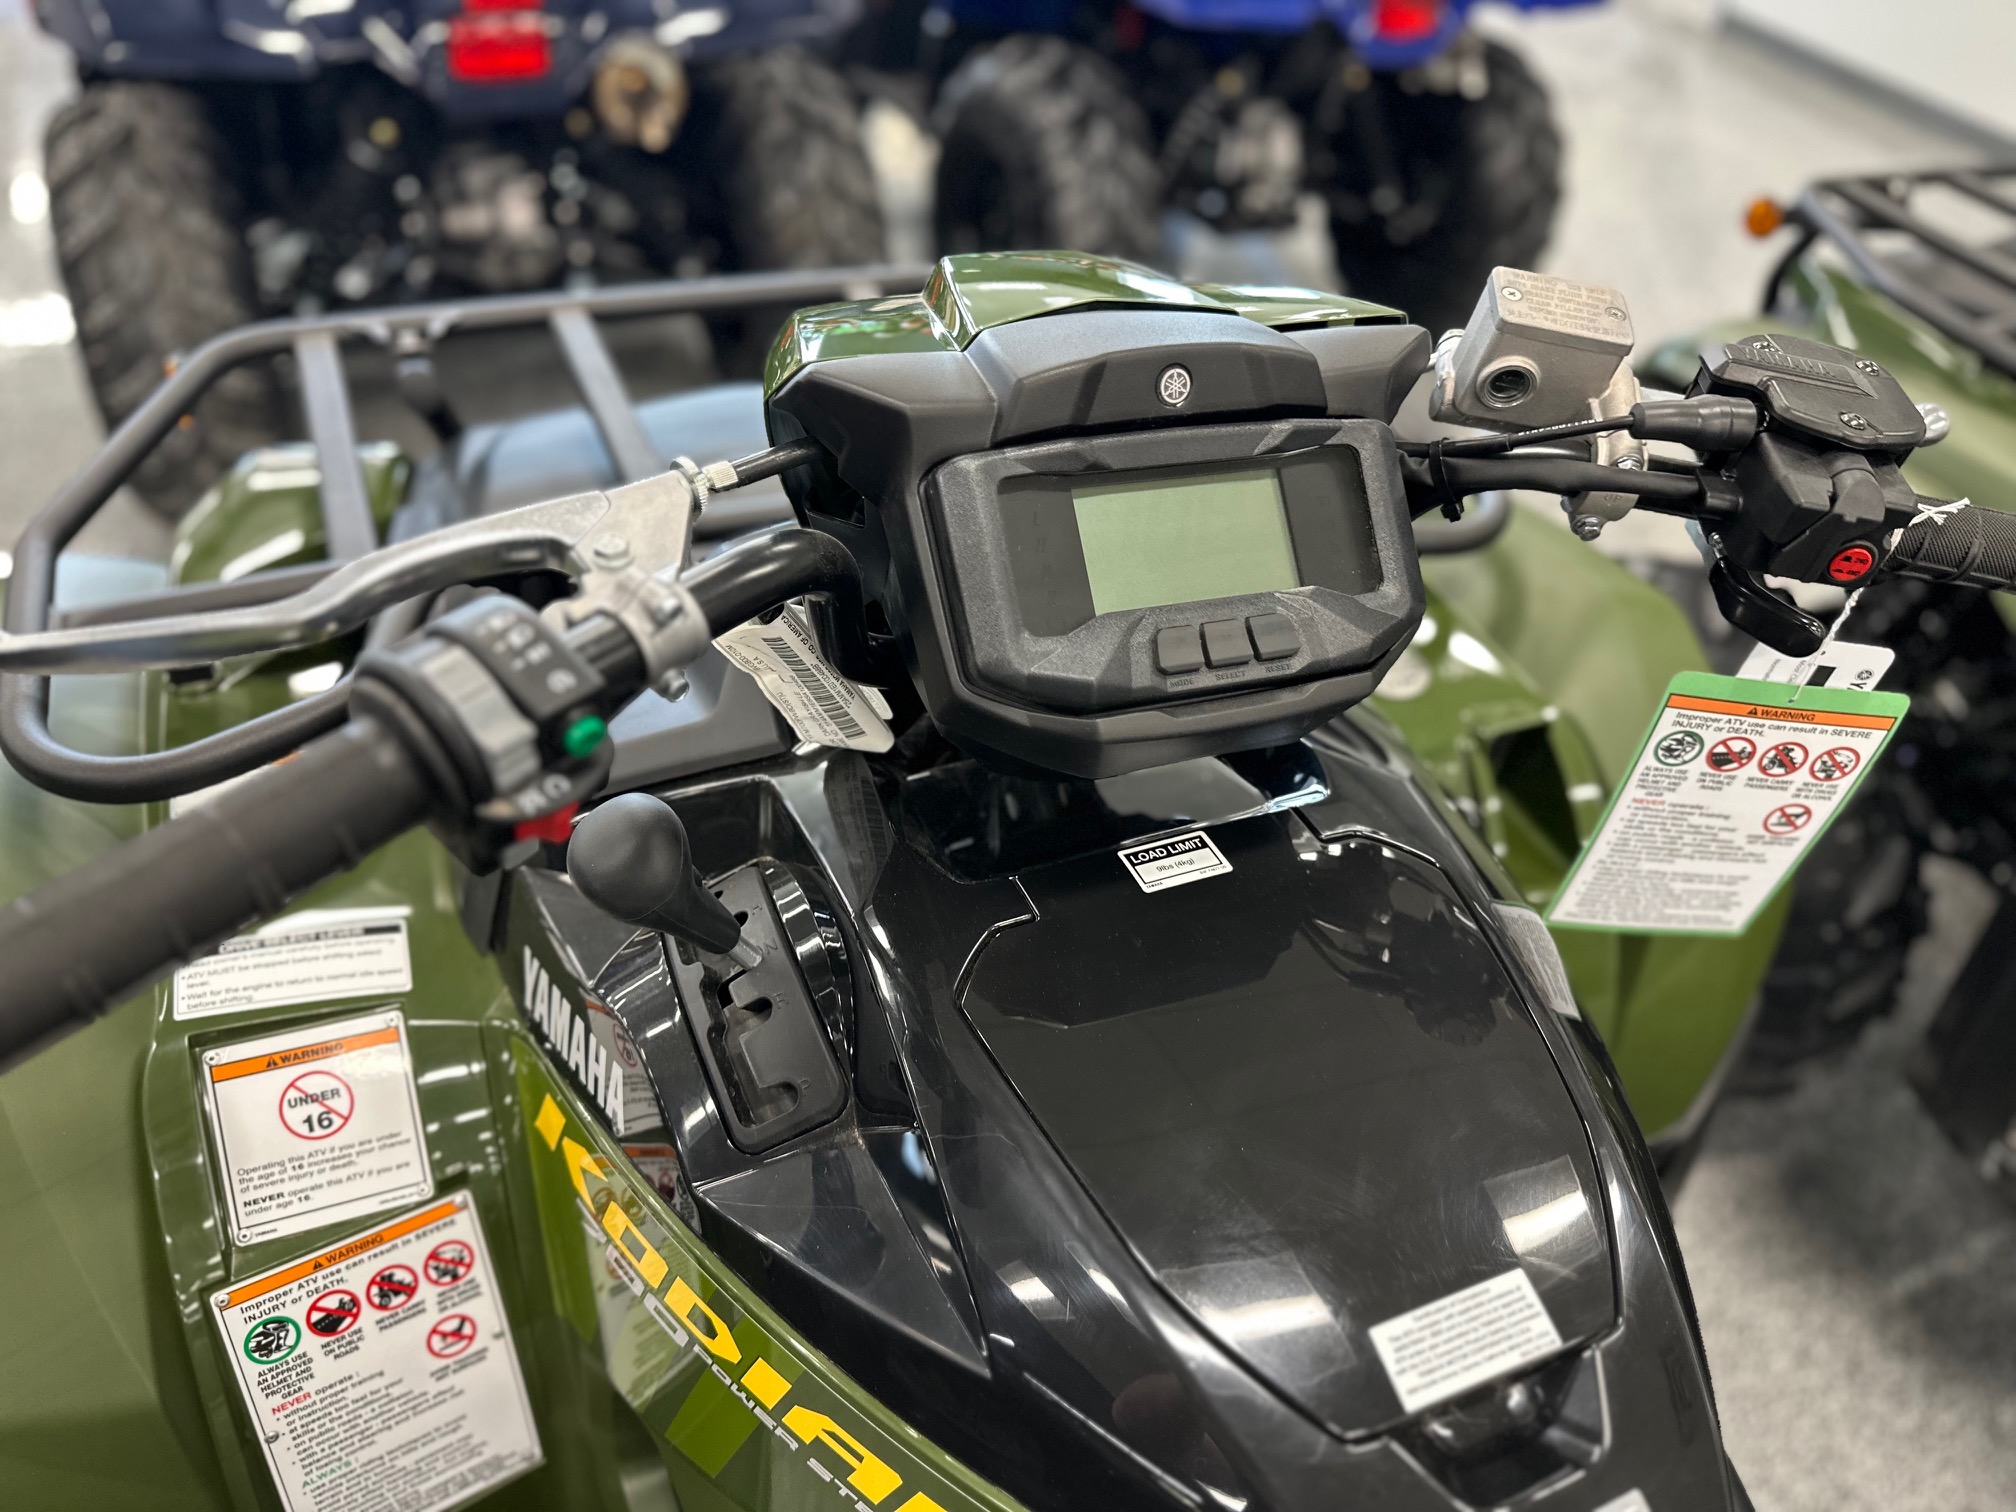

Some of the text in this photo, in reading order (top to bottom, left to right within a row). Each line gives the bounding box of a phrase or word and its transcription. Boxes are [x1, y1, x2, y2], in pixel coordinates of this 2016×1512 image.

[1170, 663, 1292, 688] MODE SELECT RESET
[1671, 720, 1712, 731] INJURY
[1726, 726, 1764, 737] DEATH.
[1674, 712, 1723, 724] Improper
[1724, 718, 1747, 726] ATV
[1747, 721, 1766, 729] use
[1788, 726, 1818, 734] result
[1818, 727, 1829, 735] in
[1830, 729, 1872, 739] SEVERE
[1761, 709, 1815, 721] WARNING
[1130, 839, 1202, 864] LOAD LIMIT
[1156, 858, 1195, 872] 9lbs (4kg)
[187, 972, 205, 981] ATV
[207, 966, 235, 976] MUST
[773, 991, 789, 1010] R
[280, 1044, 342, 1063] WARNING
[523, 944, 625, 1136] YAMAHA
[287, 1088, 340, 1108] UNDER
[798, 1077, 811, 1097] P
[303, 1109, 334, 1133] 16
[237, 1132, 401, 1177] Operating this ATV if you are under
[238, 1138, 411, 1185] the age of 16 increases your chance
[240, 1159, 358, 1194] of severe injury or death.
[243, 1161, 410, 1208] NEVER operate this ATV if you are
[244, 1194, 311, 1217] under age 16.
[254, 1228, 278, 1237] YAMAHA
[326, 1234, 384, 1263] WARNING
[240, 1219, 455, 1314] Improper ATV use can result in SEVERE
[243, 1276, 348, 1324] INJURY or DEATH.
[534, 1093, 948, 1512] KODIA
[320, 1327, 363, 1350] NEVER USE
[323, 1334, 365, 1357] ON PUBLIC
[258, 1351, 308, 1378] ALWAYS USE
[333, 1345, 360, 1360] ROADS
[257, 1357, 314, 1387] AN APPROVED
[260, 1366, 312, 1393] HELMET AND
[265, 1372, 315, 1399] PROTECTIVE
[272, 1374, 354, 1415] NEVER operate
[281, 1385, 304, 1400] GEAR
[283, 1400, 317, 1419] without
[319, 1386, 349, 1405] proper
[692, 1343, 799, 1451] POWER
[286, 1396, 348, 1427] or instruction.
[289, 1426, 298, 1434] at
[299, 1411, 333, 1429] speeds
[334, 1403, 350, 1413] too
[291, 1414, 343, 1442] skills or the
[294, 1413, 363, 1449] on public roads
[296, 1422, 361, 1456] can occur with
[299, 1451, 318, 1463] with
[302, 1460, 352, 1489] ALWAYS
